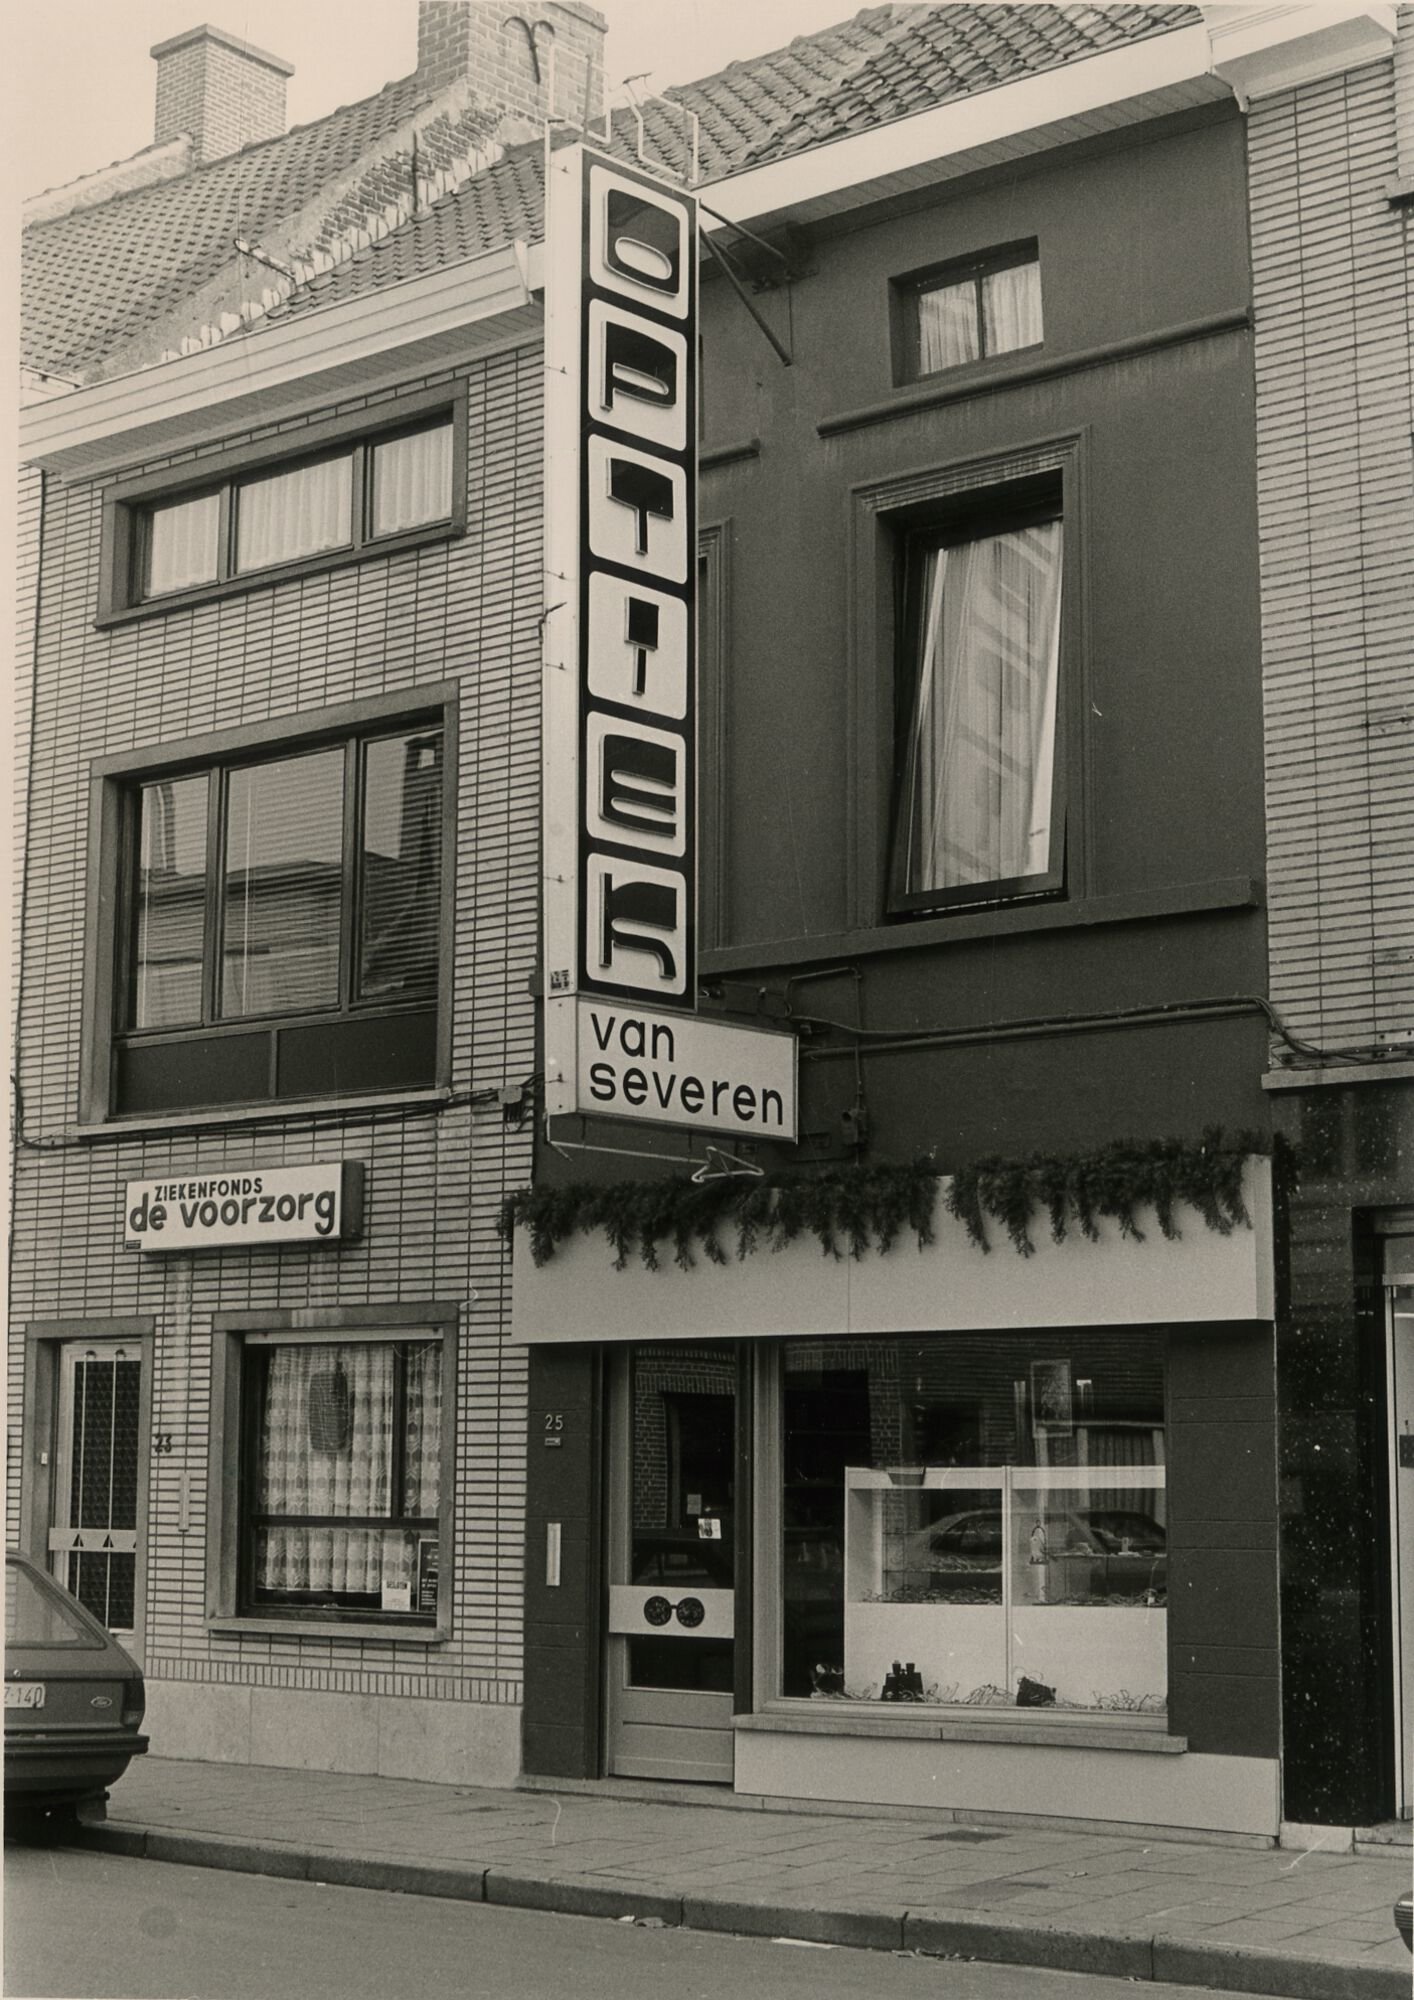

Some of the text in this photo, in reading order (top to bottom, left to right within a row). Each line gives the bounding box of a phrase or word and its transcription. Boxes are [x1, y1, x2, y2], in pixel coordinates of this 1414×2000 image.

[599, 187, 681, 980] OPTIEK
[590, 1012, 675, 1062] van
[590, 1062, 783, 1126] severen
[154, 1177, 263, 1202] ZIEKENFONDS
[129, 1190, 336, 1235] de voorzorg
[155, 1433, 172, 1453] 23
[545, 1414, 563, 1430] 25
